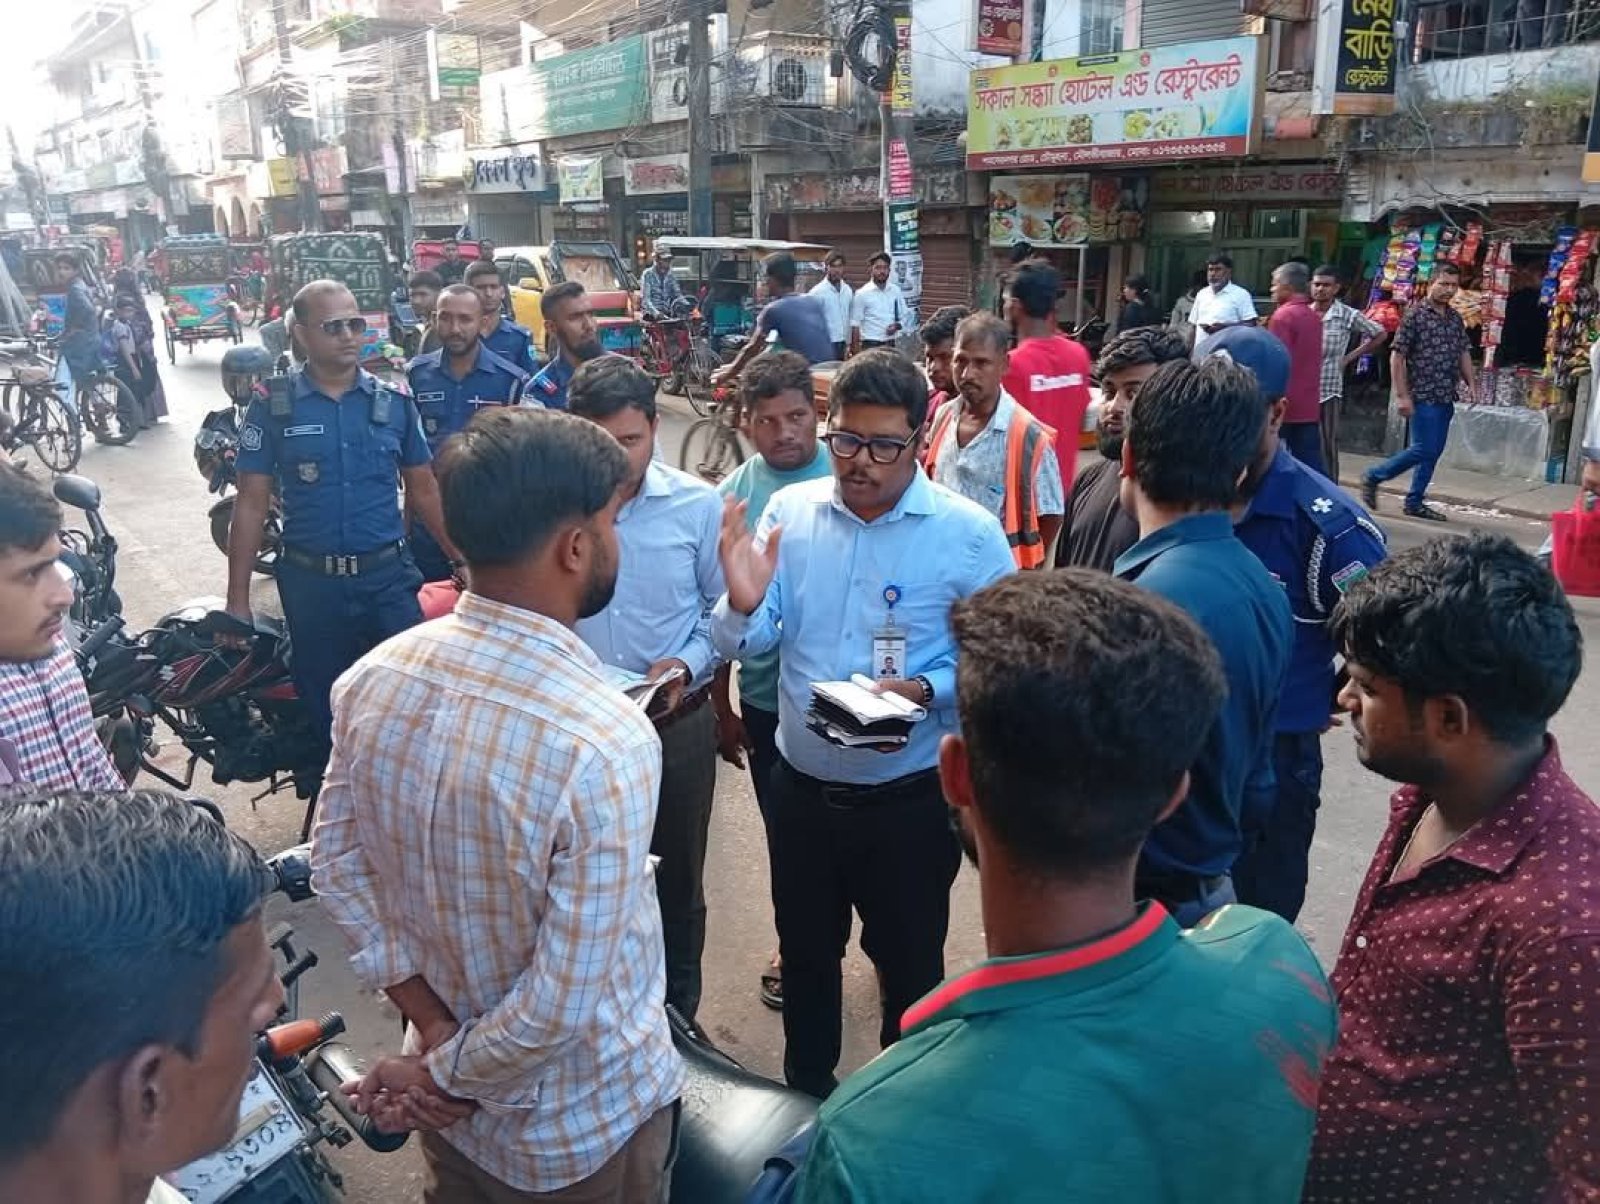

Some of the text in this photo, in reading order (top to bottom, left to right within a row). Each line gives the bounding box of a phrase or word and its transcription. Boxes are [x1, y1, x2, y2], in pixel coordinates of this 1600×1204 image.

[1344, 19, 1394, 65] বাড়ি
[975, 86, 1016, 112] সকাল
[1059, 70, 1115, 105] হোটেল
